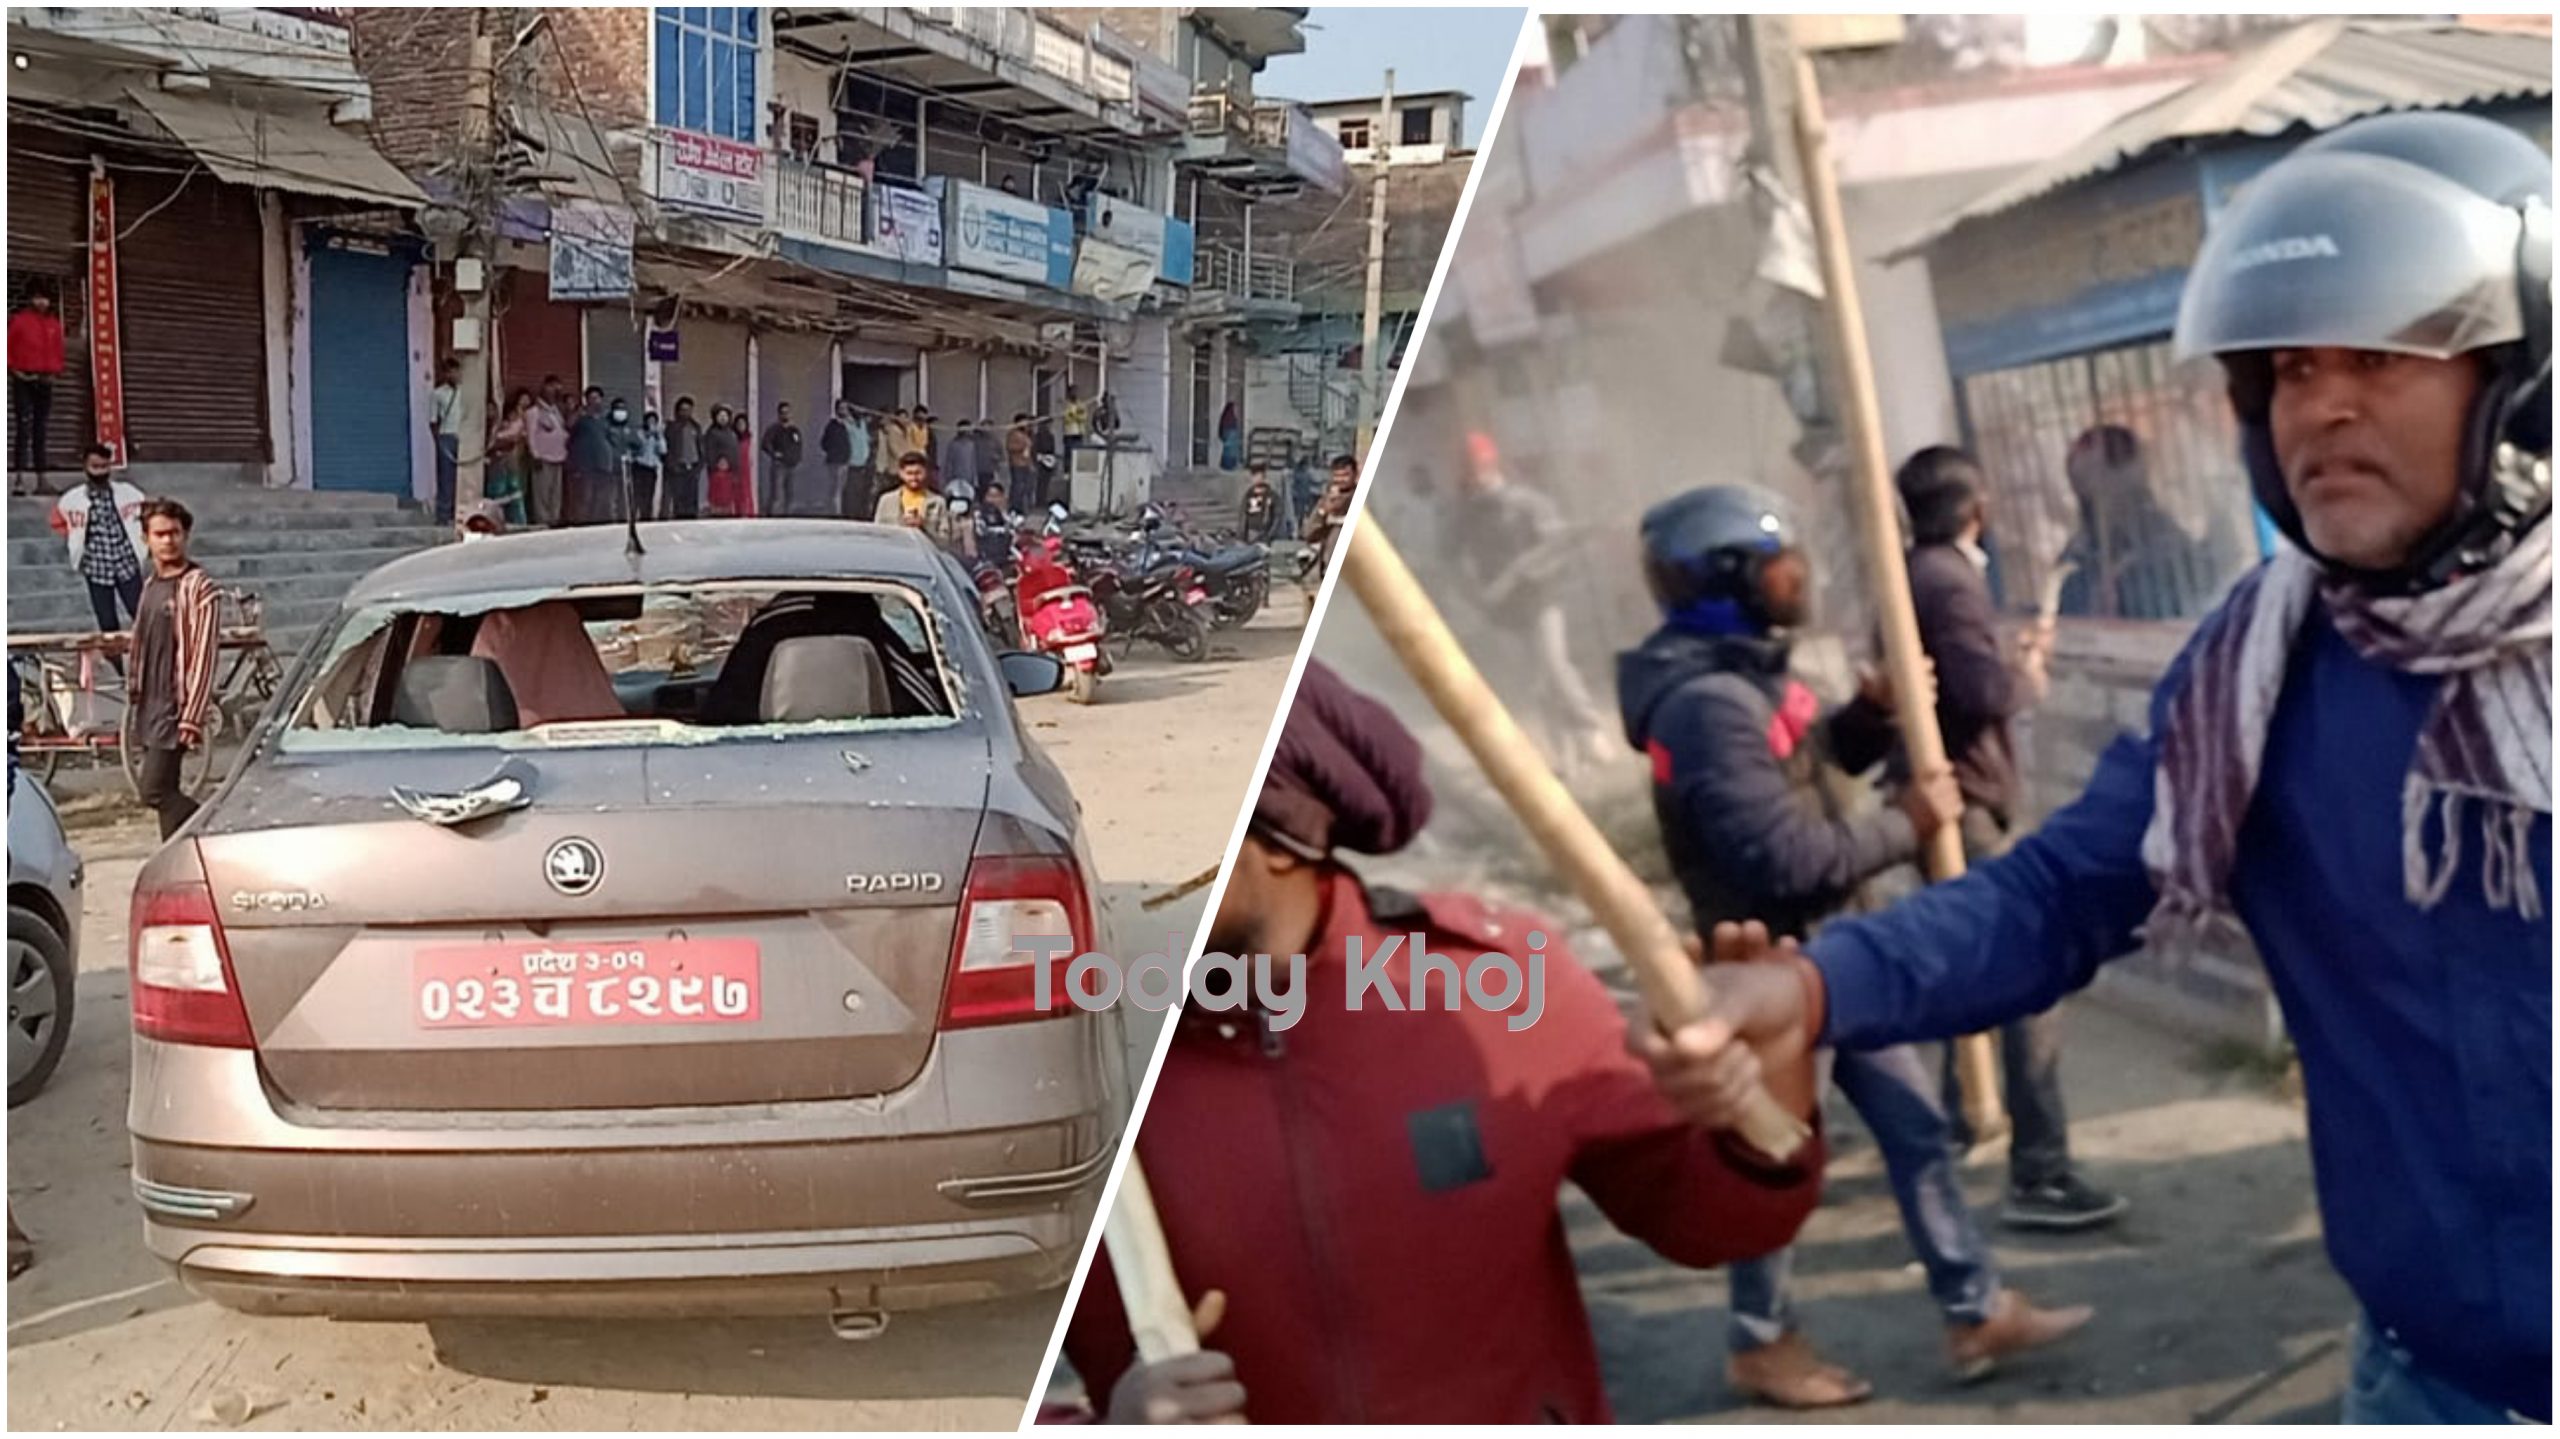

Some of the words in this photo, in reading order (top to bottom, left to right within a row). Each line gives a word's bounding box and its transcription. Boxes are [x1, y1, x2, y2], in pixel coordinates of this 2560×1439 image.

[2228, 234, 2341, 272] NDA
[846, 872, 942, 893] RAPID
[421, 979, 521, 1021] ०२३
[531, 976, 574, 1018] च
[585, 975, 749, 1017] ८२९७
